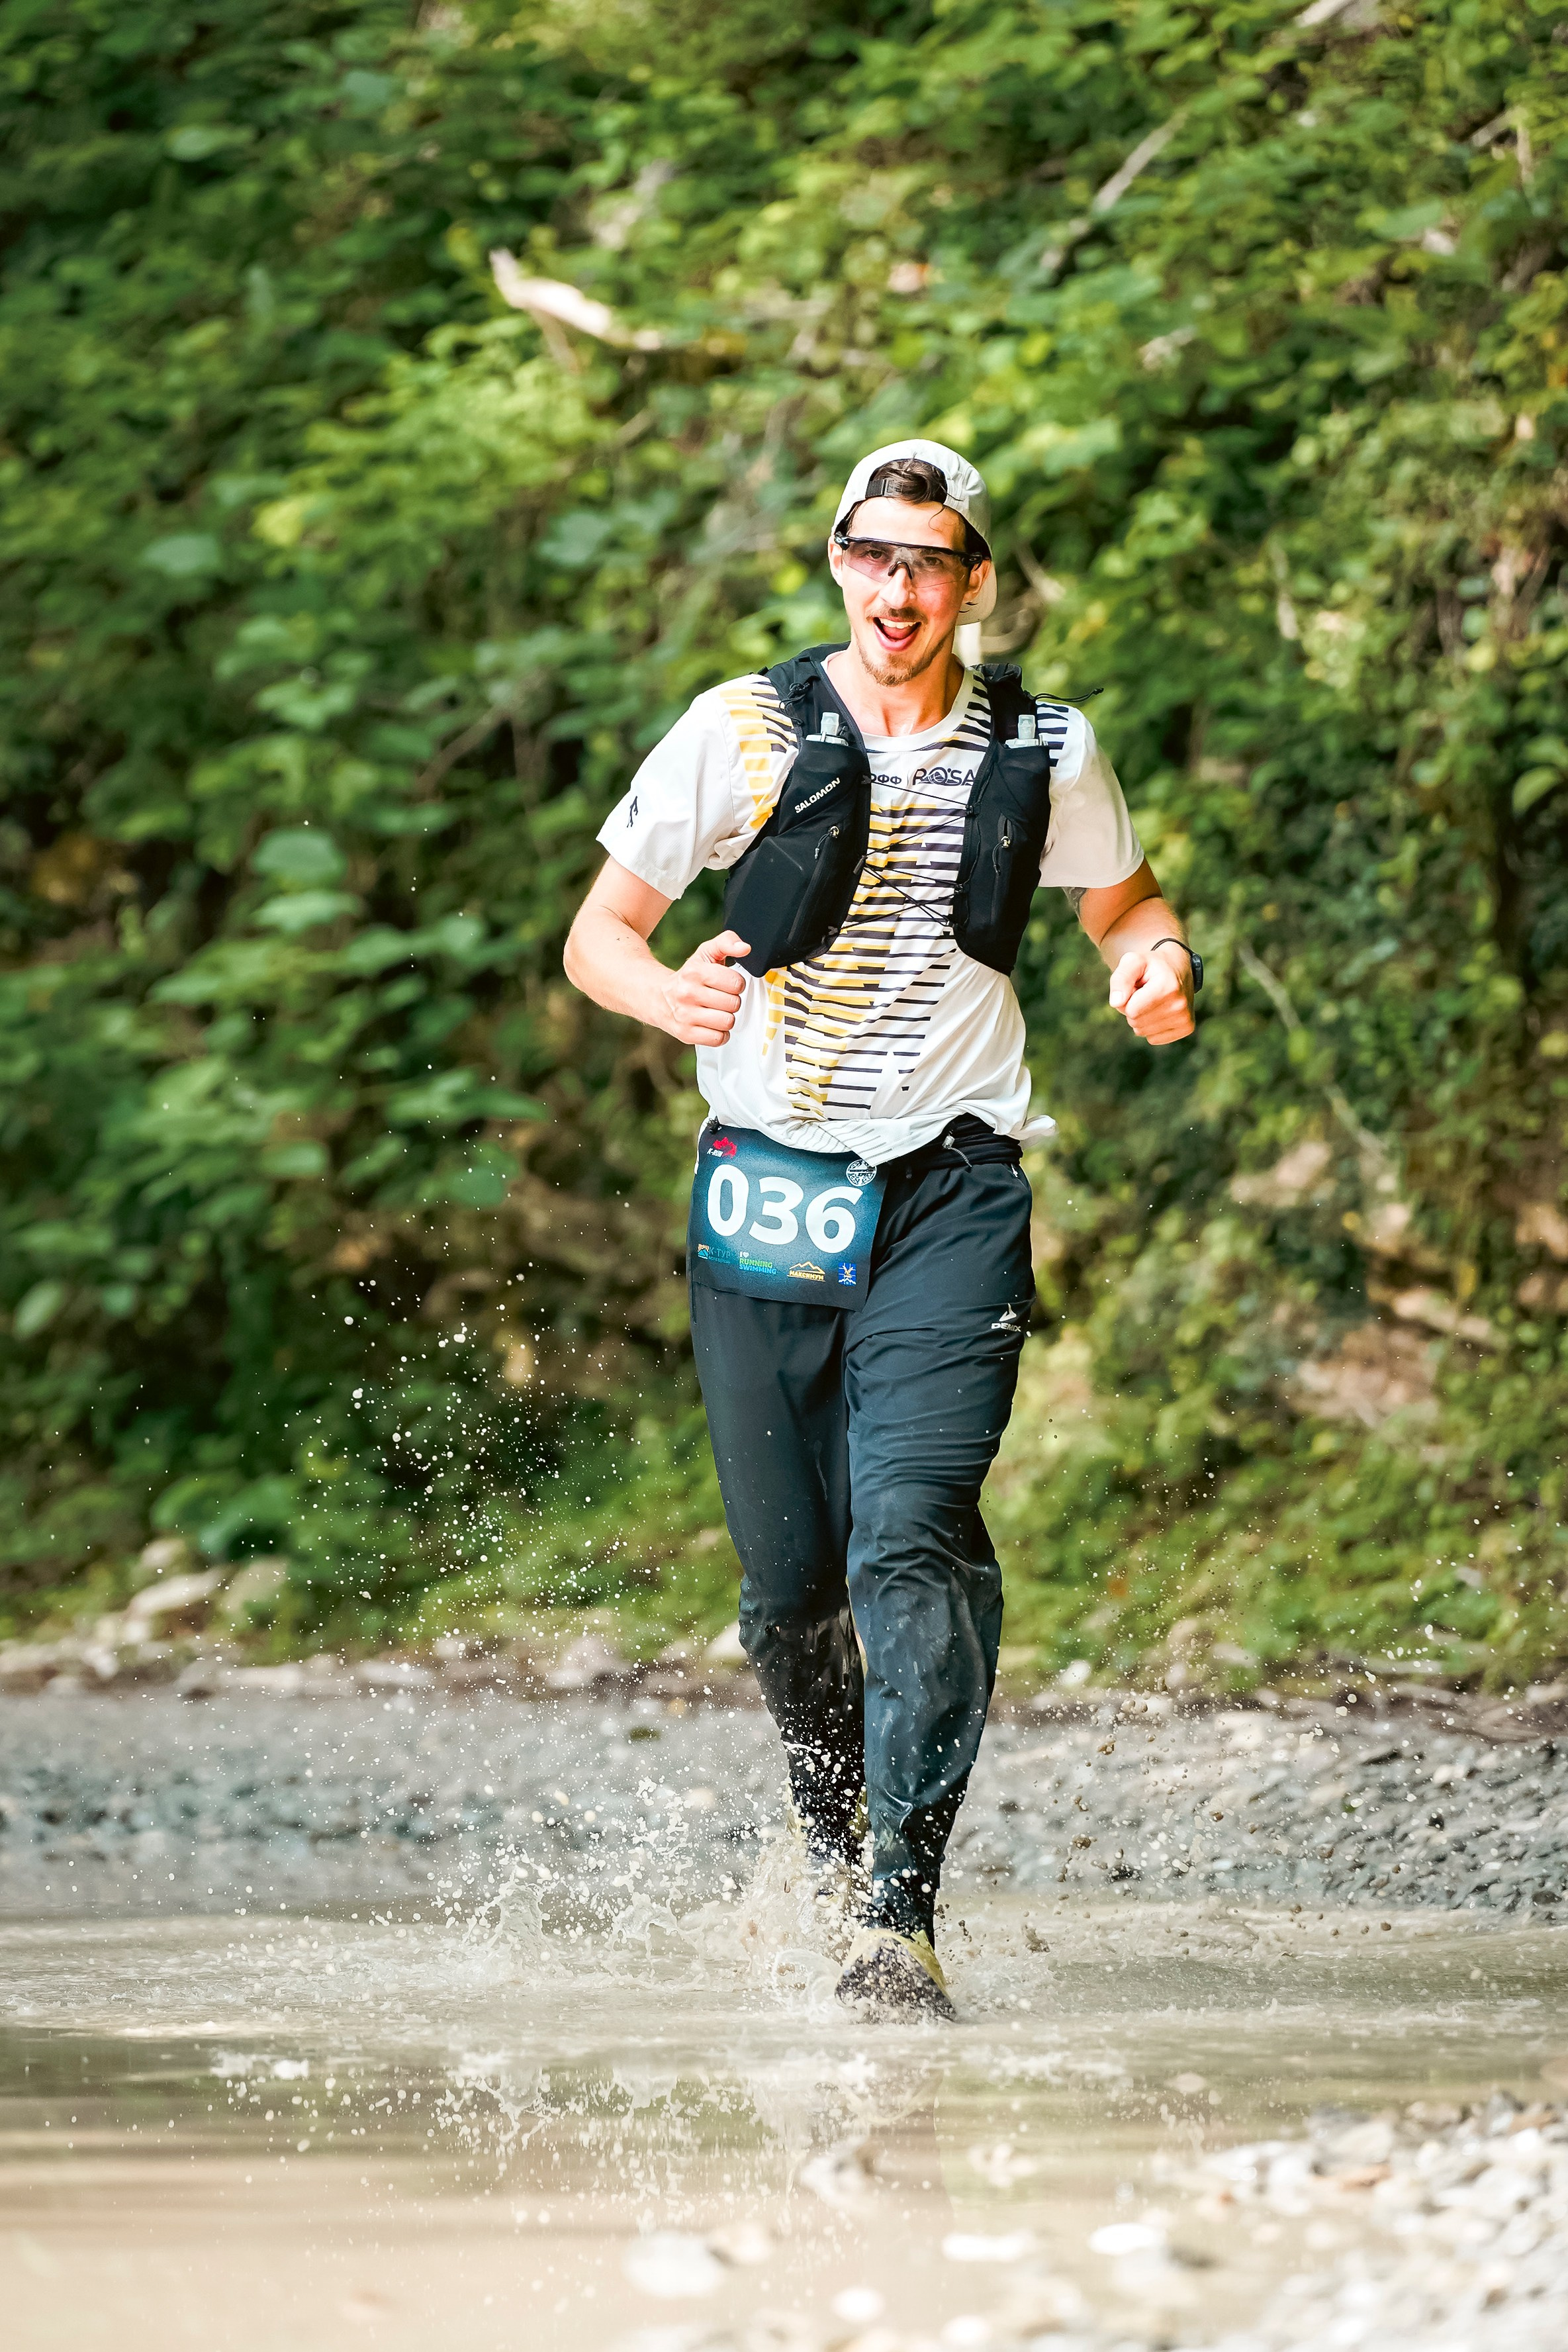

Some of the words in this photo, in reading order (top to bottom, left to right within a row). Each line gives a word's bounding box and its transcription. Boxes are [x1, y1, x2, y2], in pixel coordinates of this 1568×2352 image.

[794, 777, 841, 814] SALOMON
[707, 1164, 863, 1254] 036
[739, 1258, 773, 1268] RUNNING
[739, 1264, 777, 1274] SWIMMING
[789, 1270, 825, 1281] МАКСИМУМ
[992, 1322, 1021, 1332] DEMIX
